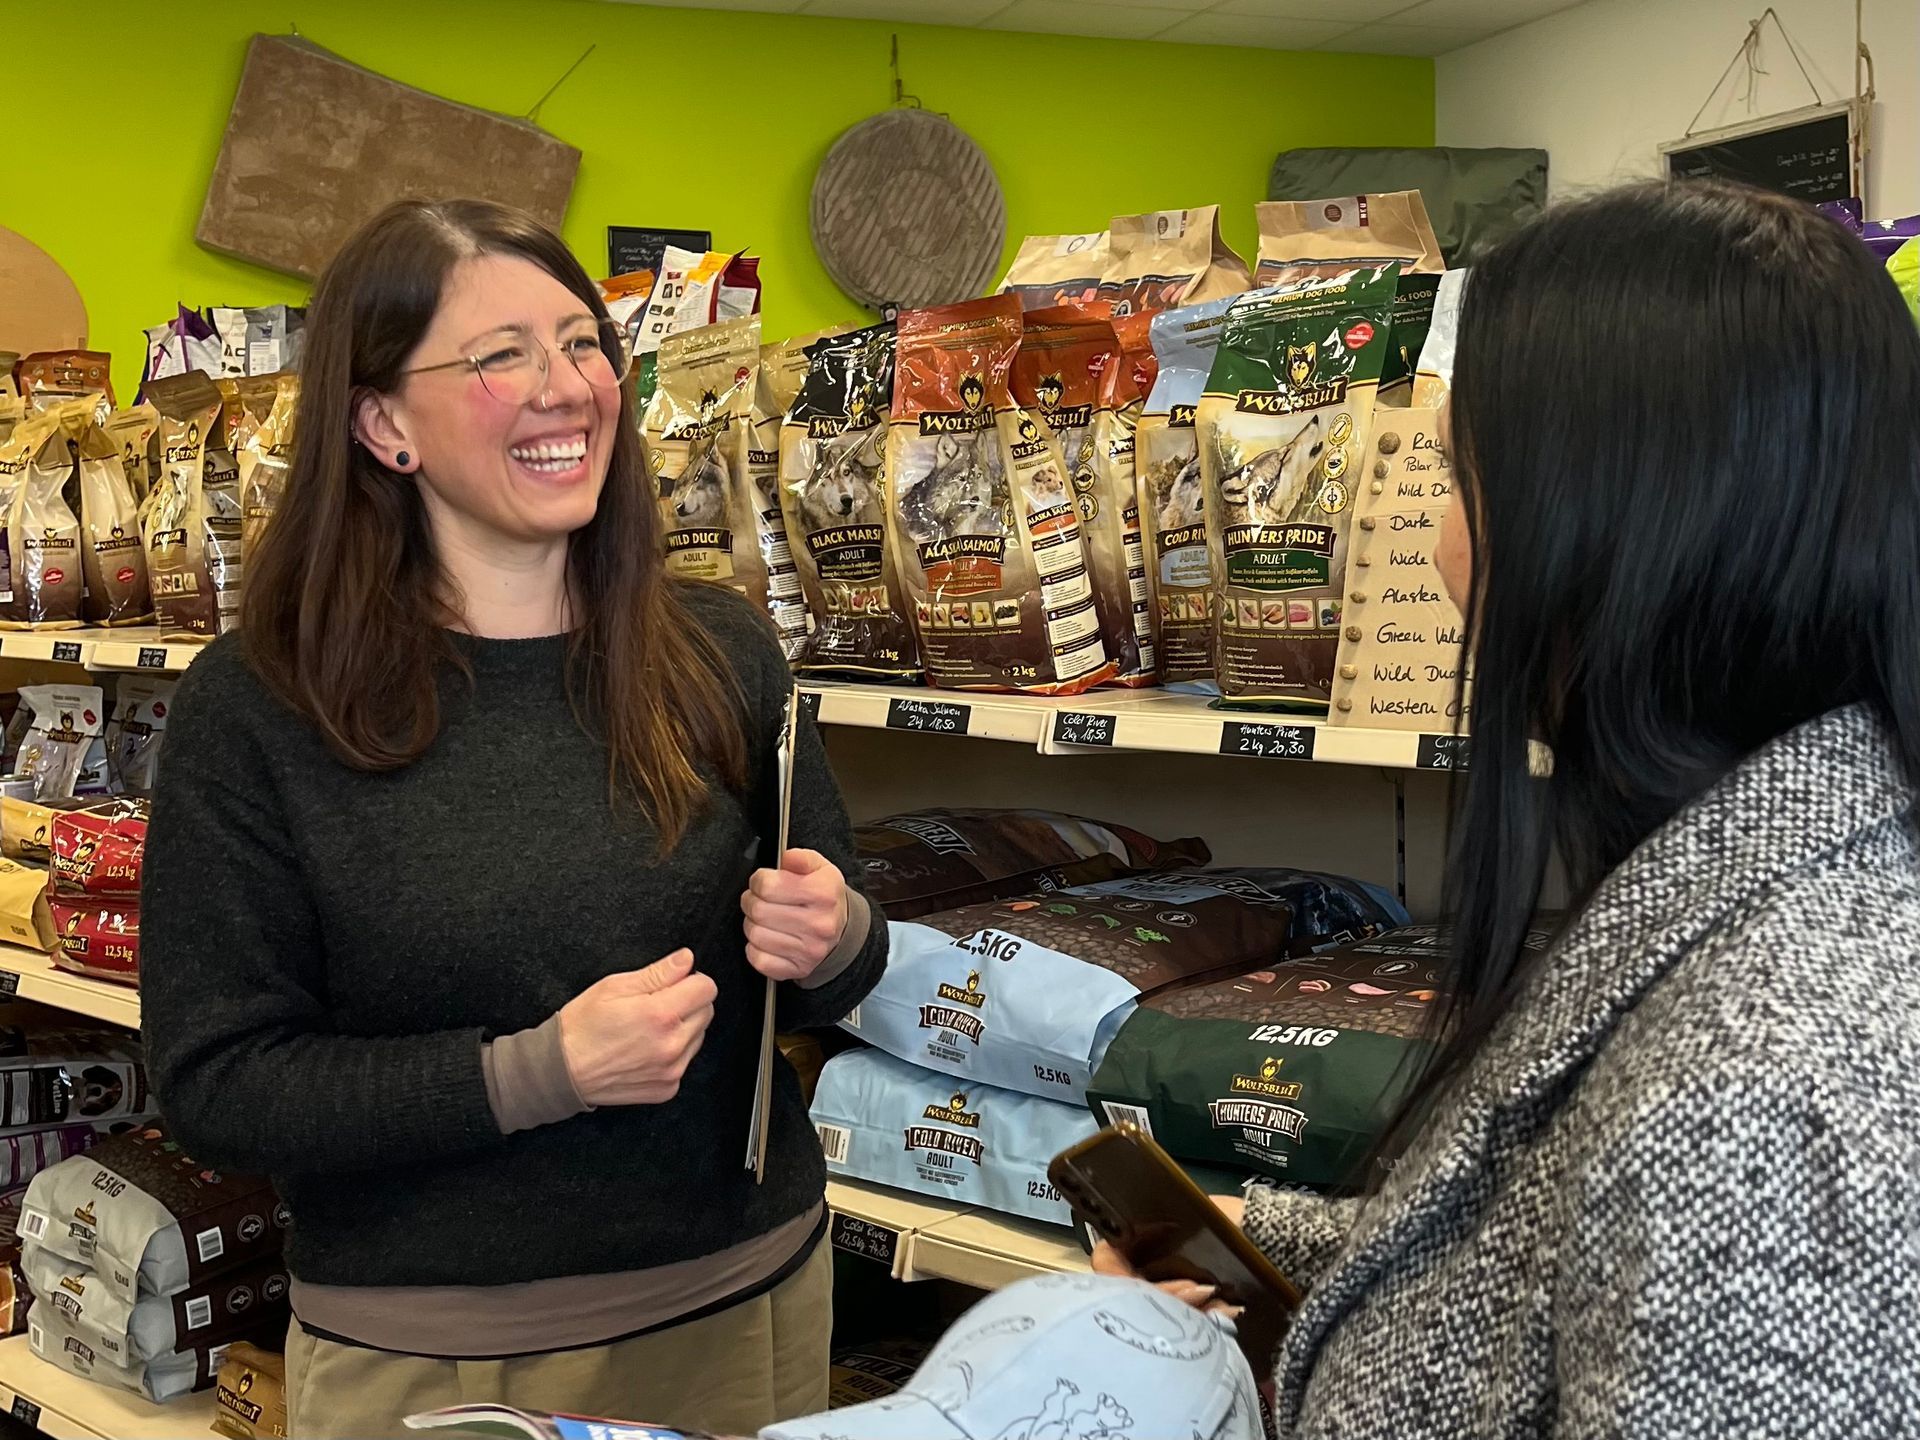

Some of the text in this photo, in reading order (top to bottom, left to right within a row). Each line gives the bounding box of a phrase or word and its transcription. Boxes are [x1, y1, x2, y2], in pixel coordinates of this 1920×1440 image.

[1306, 290, 1323, 299] DOG
[1324, 285, 1347, 296] FOOD
[1408, 290, 1433, 300] FOOD
[1244, 381, 1344, 411] WOLFSBLUT
[1043, 407, 1088, 426] SBLUT
[1404, 456, 1432, 472] Polar
[1398, 482, 1452, 498] Wild Du
[1390, 512, 1434, 531] Dark
[669, 532, 721, 547] WILD DUCK
[812, 532, 844, 549] BLACK
[1164, 530, 1190, 547] COLD
[1228, 527, 1325, 546] HUNTERS PRIDE
[840, 549, 866, 560] ADULT
[962, 538, 1001, 554] SALMON
[683, 552, 708, 563] ADULT
[1253, 552, 1288, 566] ADULT
[1390, 549, 1428, 566] Wide
[1382, 584, 1440, 604] Alaska
[1377, 622, 1426, 644] Green
[886, 649, 899, 661] kg
[1012, 665, 1037, 677] 2 kg
[1374, 663, 1415, 682] Wild
[896, 700, 961, 716] Alaska Salmon
[1370, 696, 1437, 714] Western
[928, 716, 956, 731] 18,50
[1063, 713, 1108, 727] Cold River
[1080, 728, 1107, 742] 18,50
[1240, 724, 1304, 740] Hunters Pride
[1239, 738, 1305, 757] 2 kg 20,30
[106, 865, 136, 881] 12,5 kg
[104, 944, 134, 962] 12,5 kg
[950, 930, 1022, 963] 2,5KG
[930, 1008, 978, 1036] COLD RIVER
[937, 1029, 959, 1047] ADULT
[1248, 1024, 1340, 1047] 12,5KG
[1034, 1064, 1072, 1085] 12,5KG
[1236, 1077, 1298, 1096] WOLFSBLUT
[52, 1078, 62, 1114] Vetline
[927, 1106, 977, 1125] WOLFSBLUT
[1220, 1104, 1298, 1133] HUNTERS PRIDE
[913, 1129, 977, 1157] COLD RIVER
[1243, 1127, 1272, 1148] ADULT
[926, 1151, 955, 1169] ADULT
[91, 1170, 127, 1198] 12,5KG
[842, 1217, 888, 1242] Cold River
[218, 1387, 261, 1420] WOLFSBLUT
[273, 1423, 286, 1438] 12
